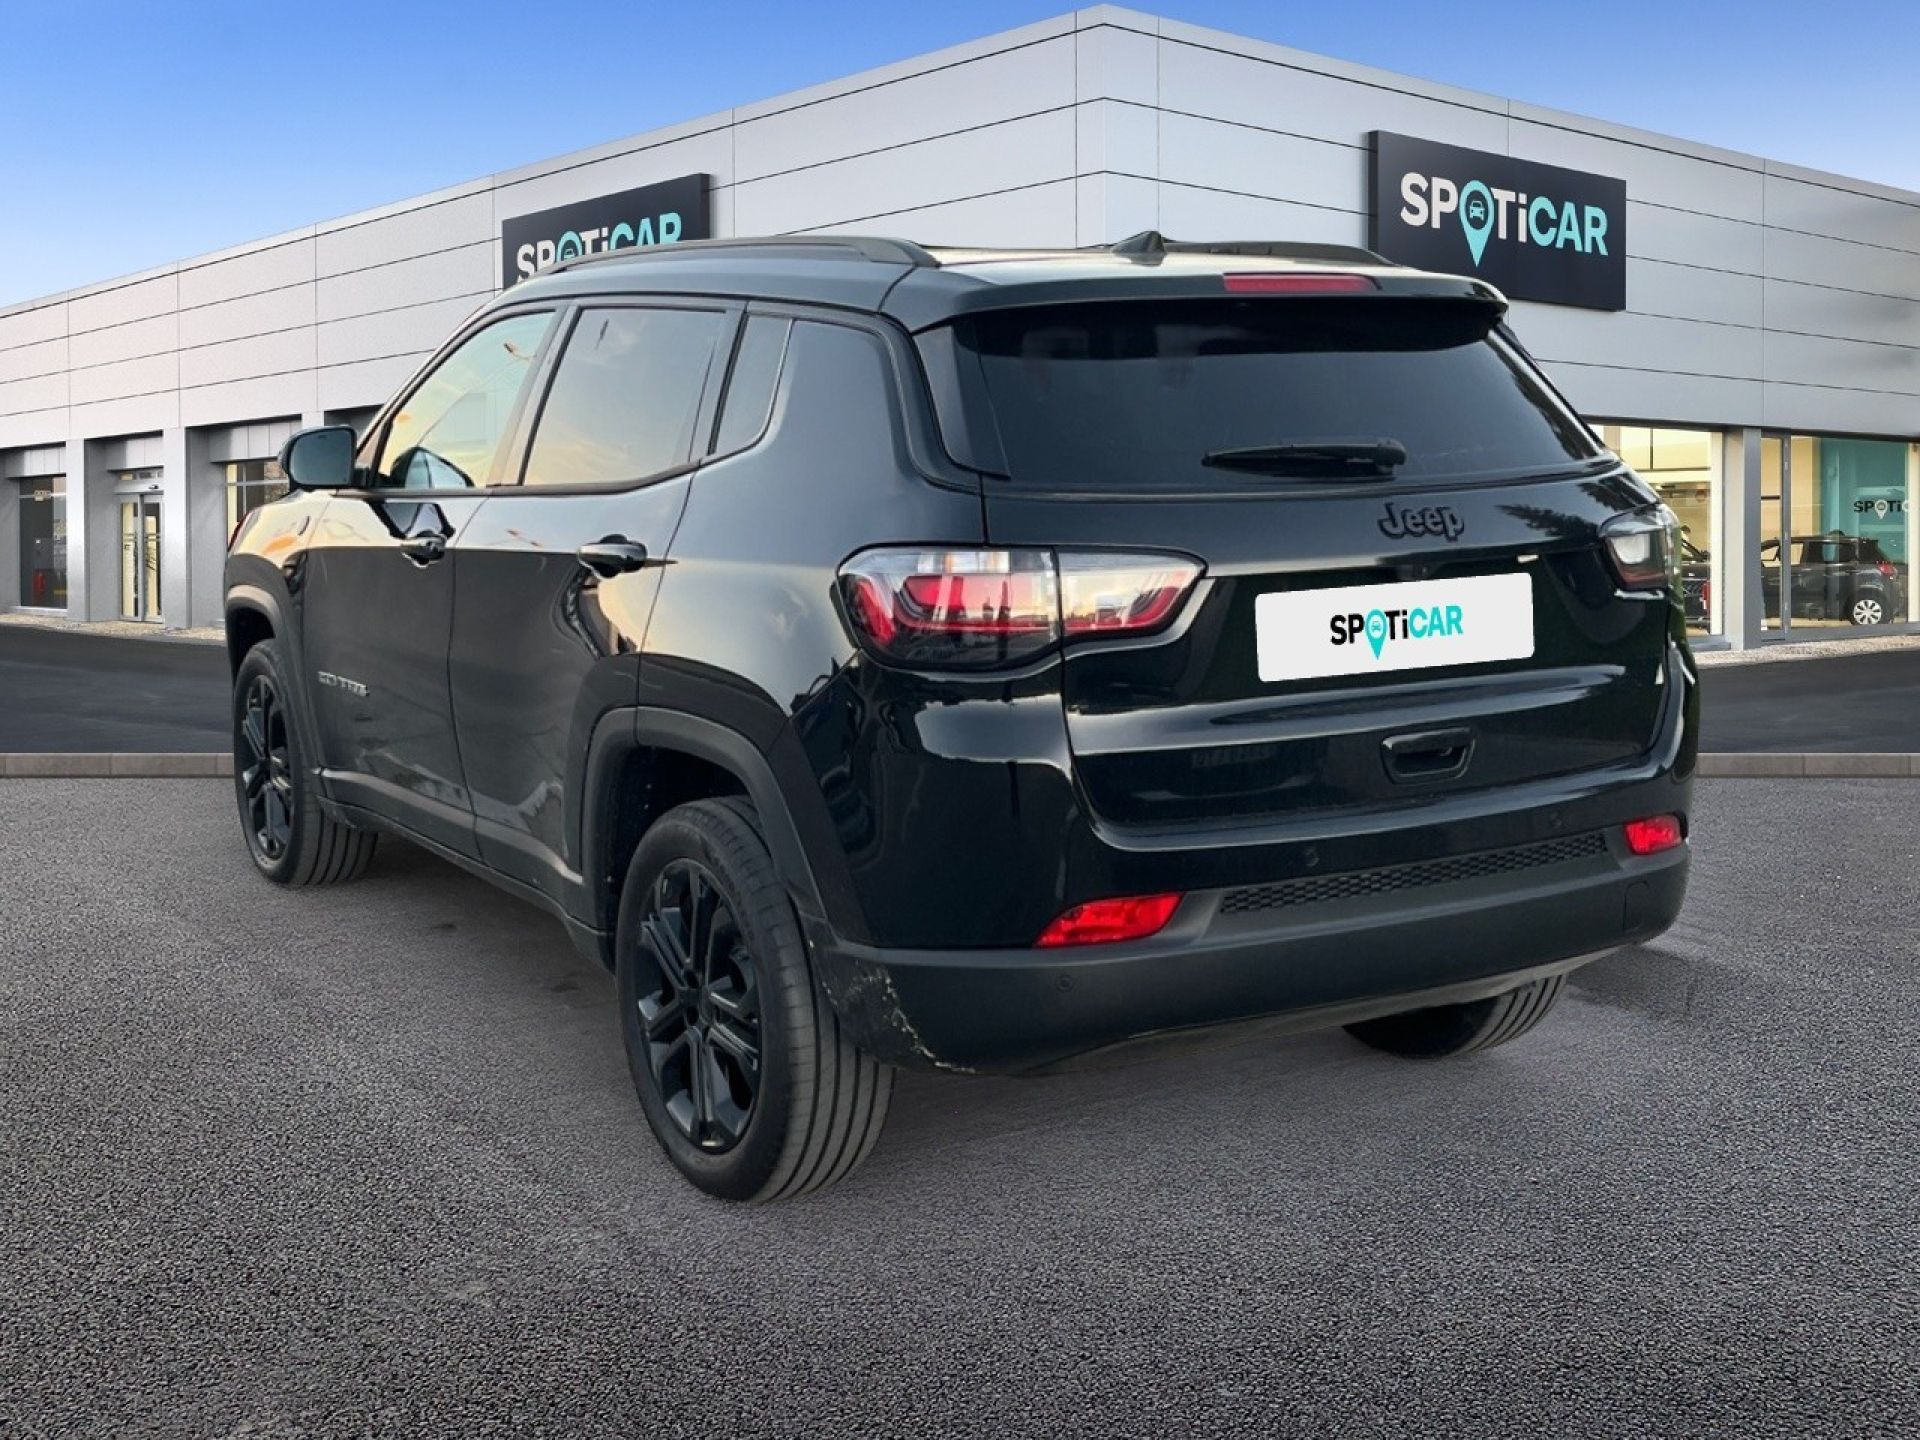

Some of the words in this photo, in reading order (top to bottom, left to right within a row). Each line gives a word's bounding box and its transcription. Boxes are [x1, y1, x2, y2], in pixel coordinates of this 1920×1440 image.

[1400, 172, 1608, 267] SPOTiCAR
[1378, 503, 1464, 541] Jeep
[1330, 605, 1463, 660] SPOTiCAR
